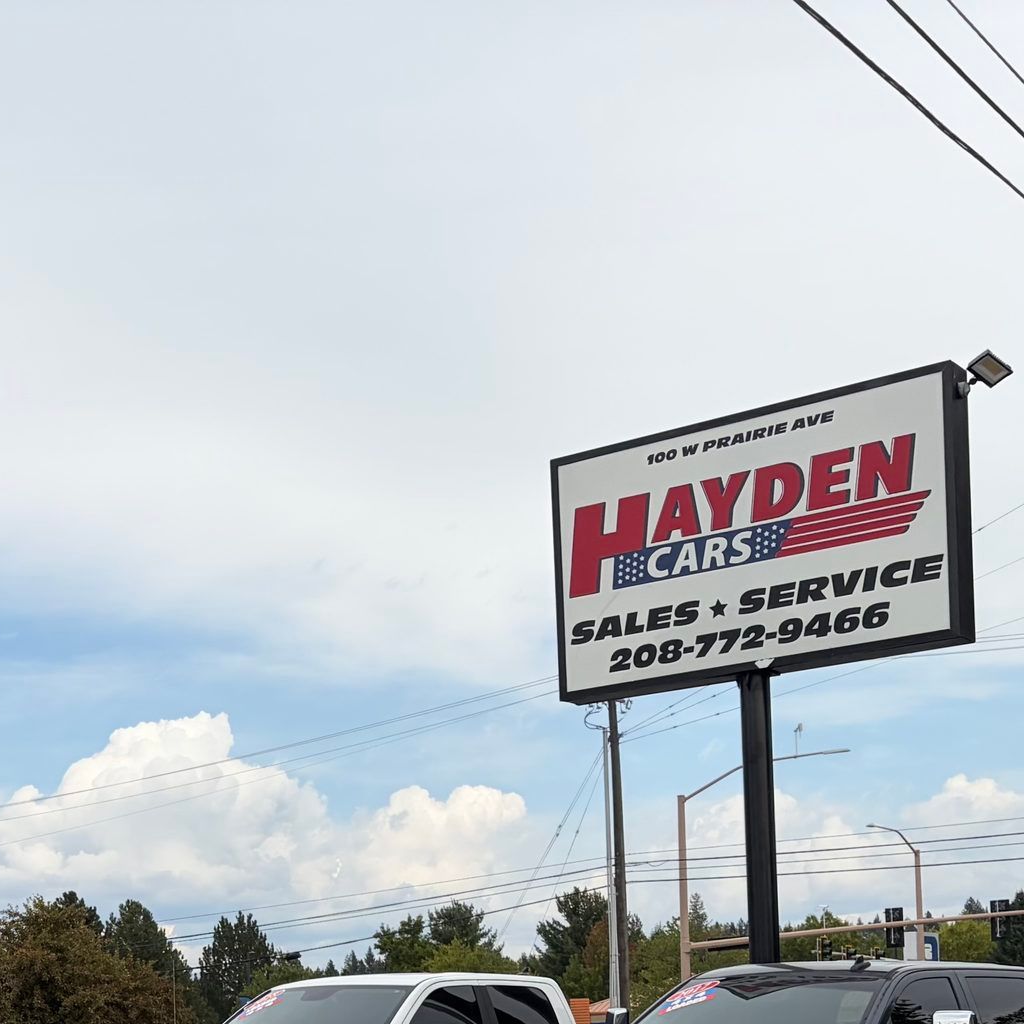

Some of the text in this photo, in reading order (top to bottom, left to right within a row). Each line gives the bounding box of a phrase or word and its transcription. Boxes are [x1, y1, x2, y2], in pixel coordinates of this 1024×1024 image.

[647, 410, 835, 466] 100 W PRAIRIE AVE
[569, 433, 916, 598] HAYDEN
[646, 531, 753, 580] CARS
[571, 554, 944, 646] SALES SERVICE
[609, 602, 891, 673] 208-772-9466
